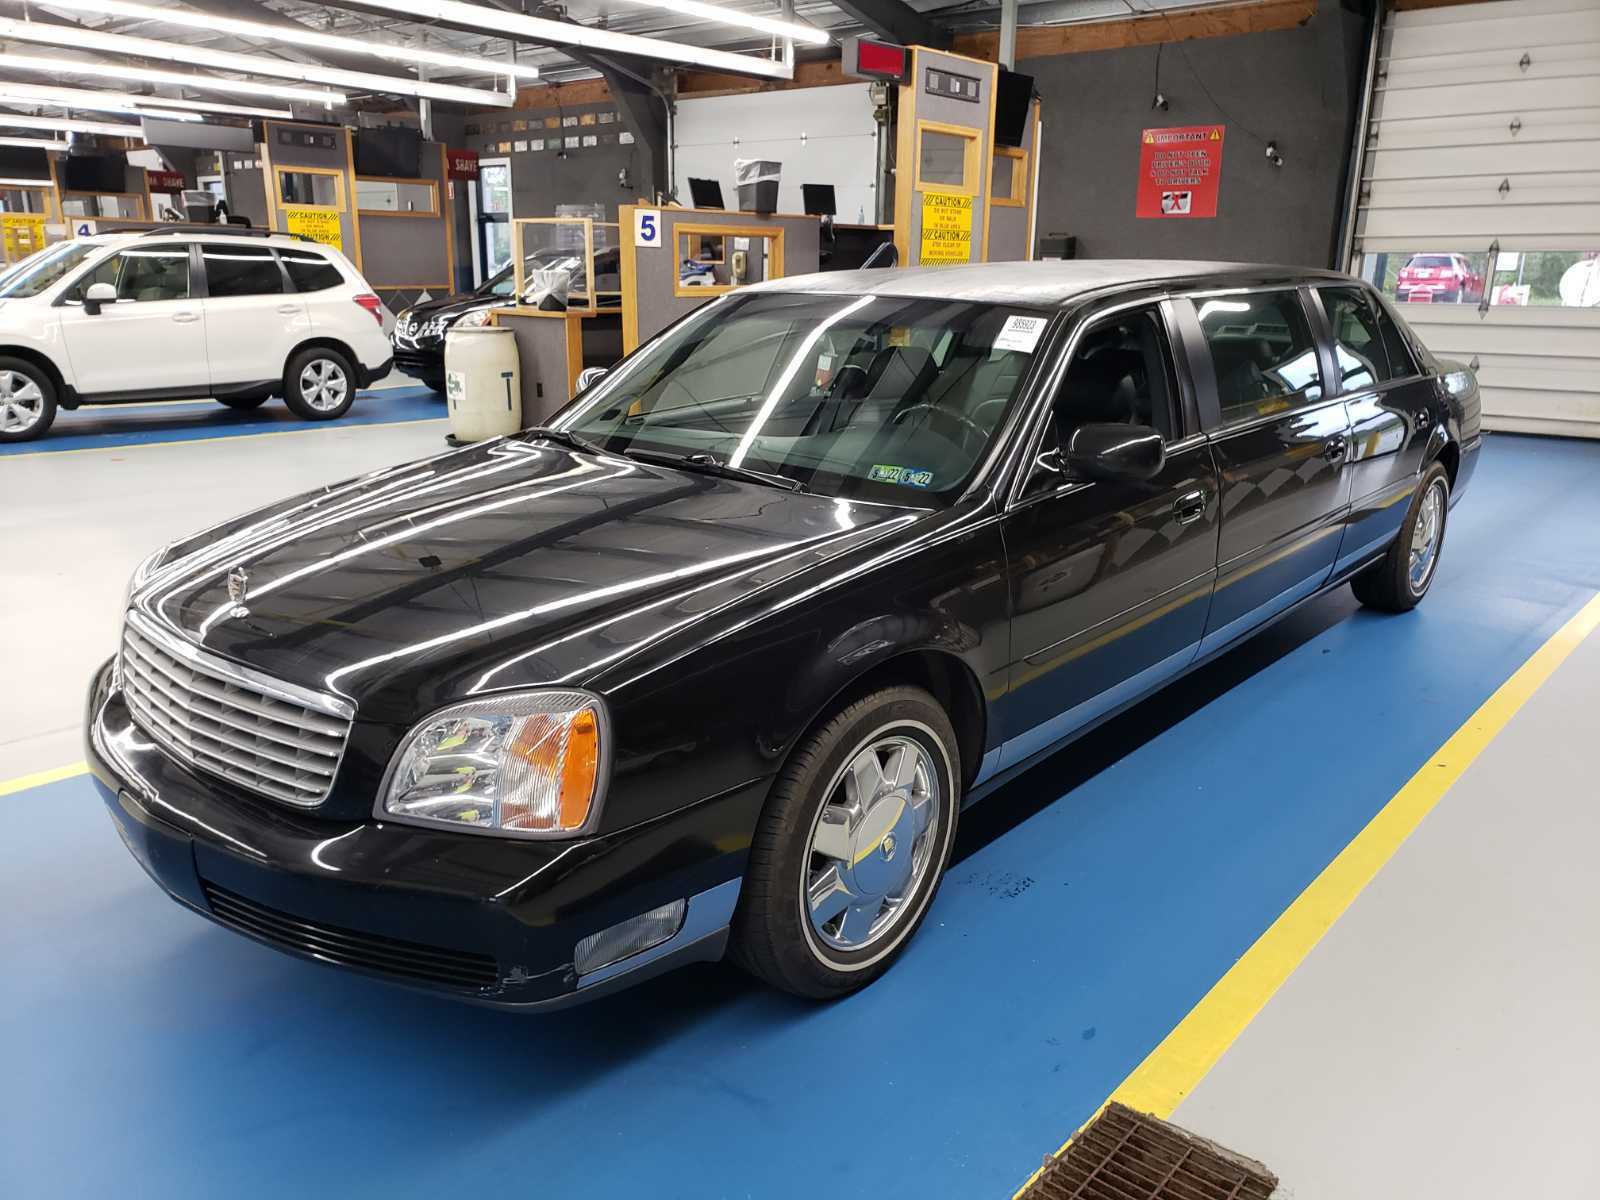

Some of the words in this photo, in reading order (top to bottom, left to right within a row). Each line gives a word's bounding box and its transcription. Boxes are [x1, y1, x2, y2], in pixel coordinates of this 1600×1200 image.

[1156, 132, 1207, 143] IMPORTANT
[935, 196, 961, 207] CAUTION
[77, 223, 91, 236] 4
[641, 215, 656, 241] 5
[933, 231, 960, 241] CAUTION
[919, 472, 930, 484] 22
